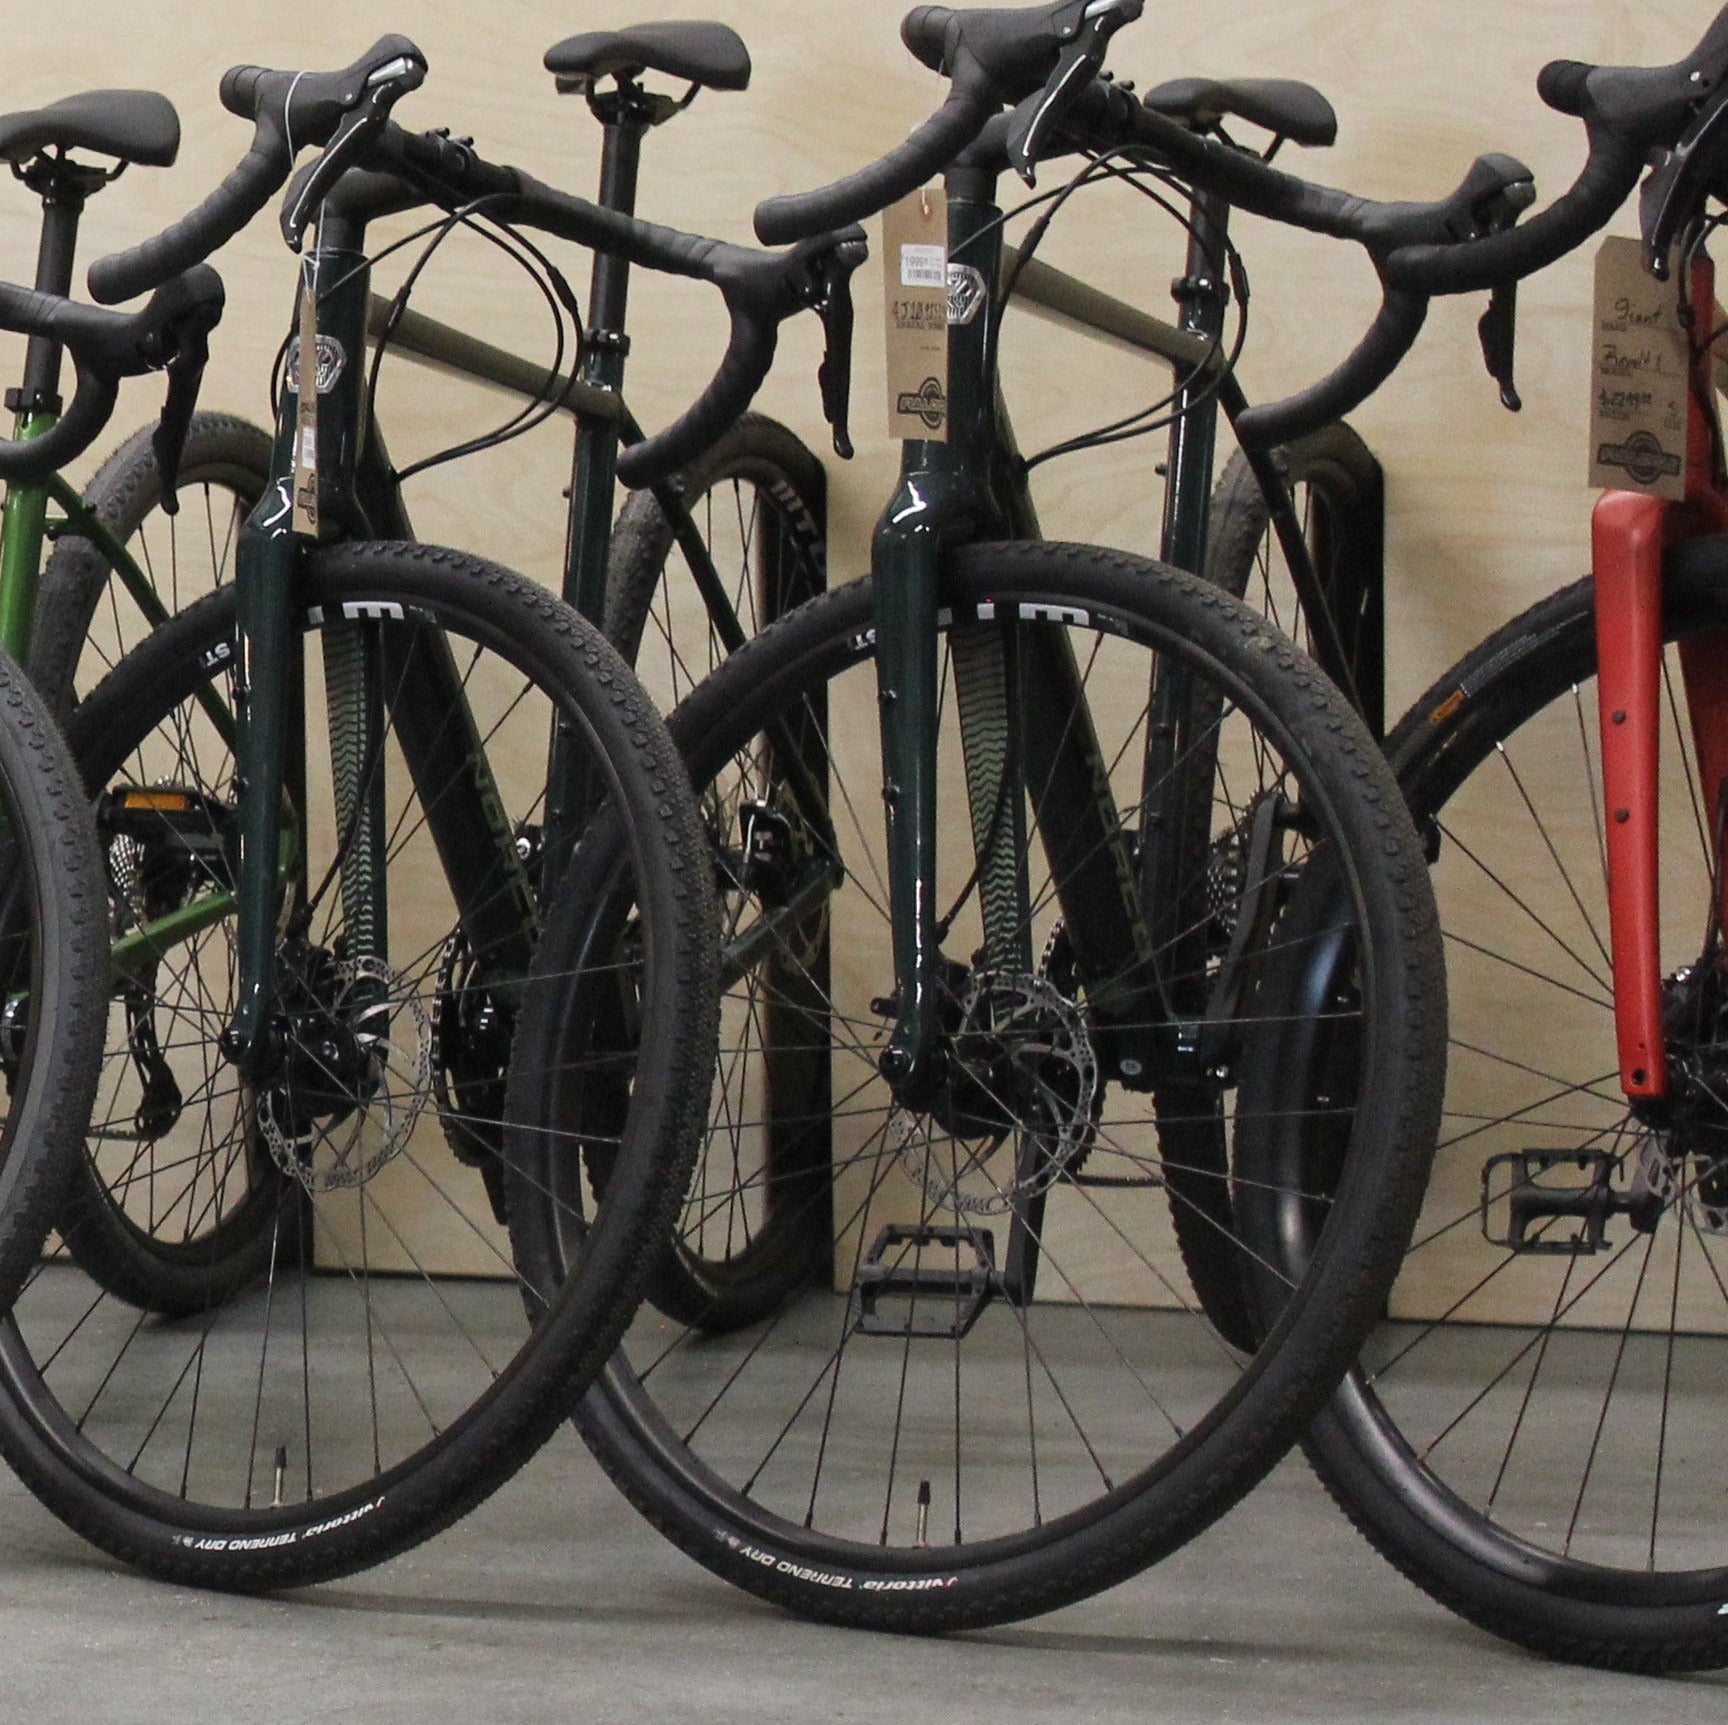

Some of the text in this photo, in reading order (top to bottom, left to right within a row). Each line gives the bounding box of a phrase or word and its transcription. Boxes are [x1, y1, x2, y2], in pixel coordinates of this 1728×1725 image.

[194, 1538, 228, 1551] DRY
[228, 1531, 297, 1551] TERRENO
[740, 1545, 777, 1567] DRY
[775, 1560, 854, 1589] TERRENO
